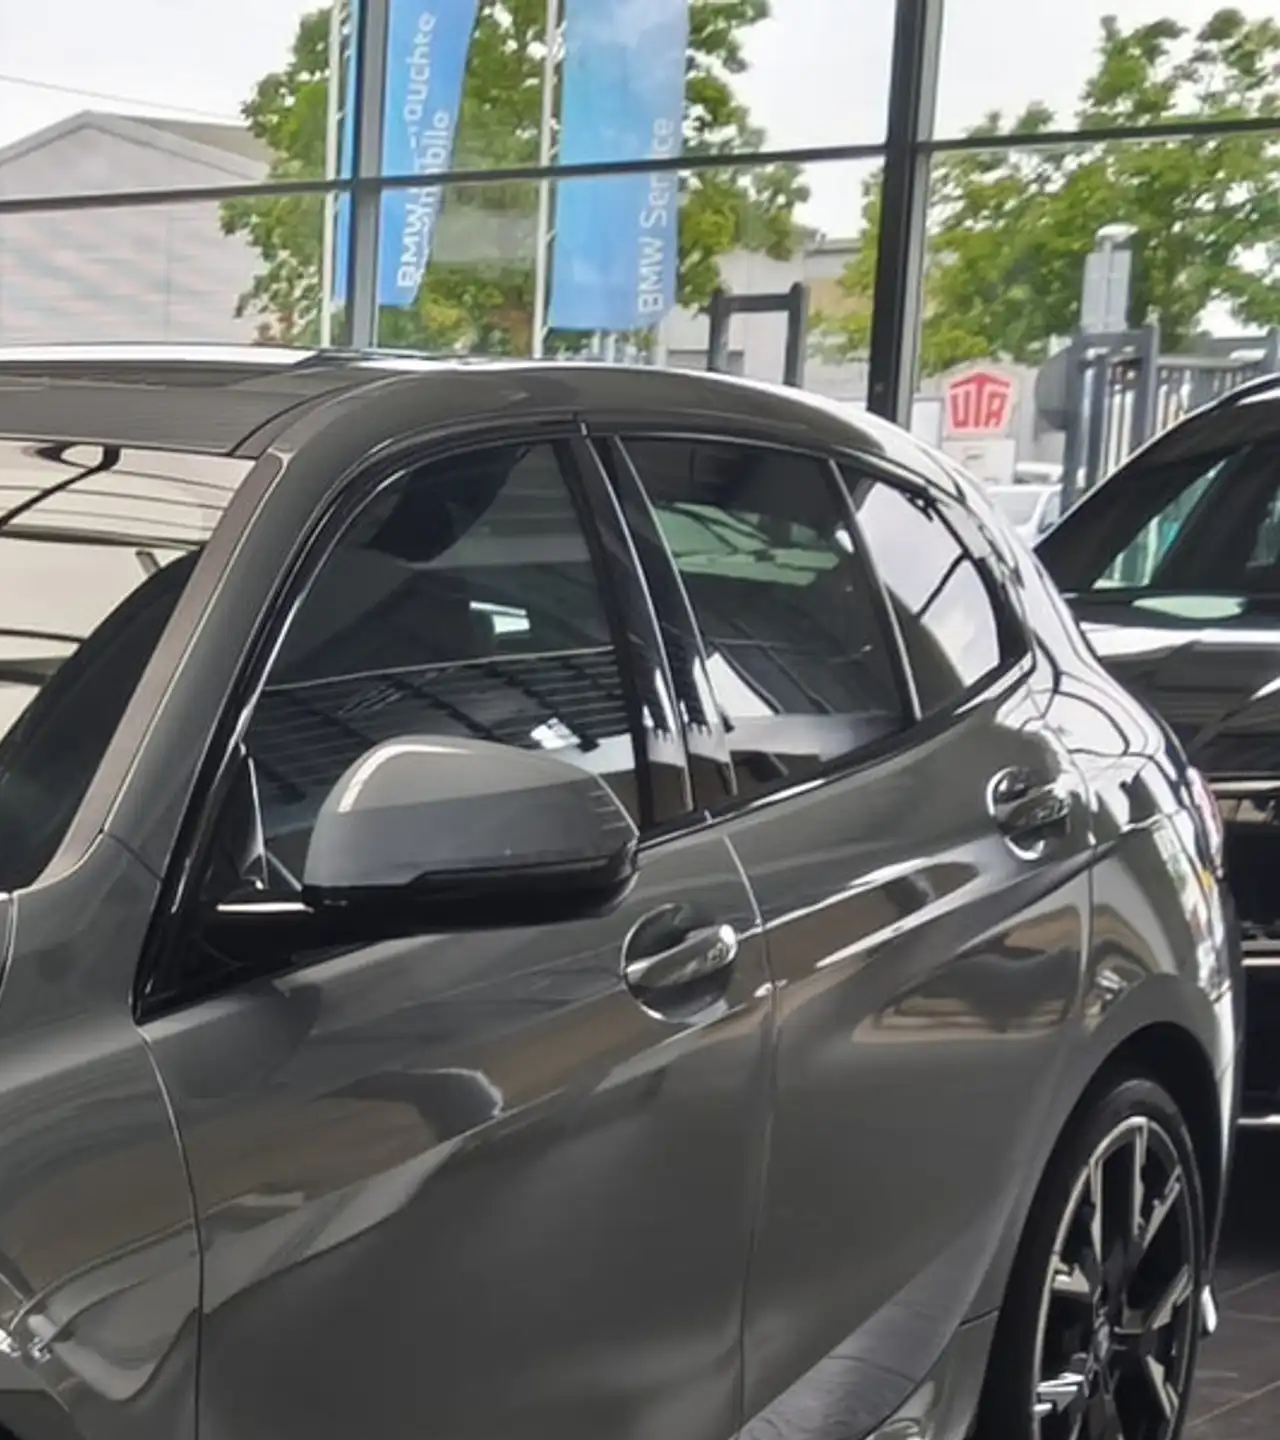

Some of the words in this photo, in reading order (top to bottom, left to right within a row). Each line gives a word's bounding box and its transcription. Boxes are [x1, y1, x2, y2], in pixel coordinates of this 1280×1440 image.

[640, 117, 674, 228] Serice
[396, 202, 423, 288] BMW
[637, 236, 664, 313] BMW
[949, 372, 1011, 428] UTA
